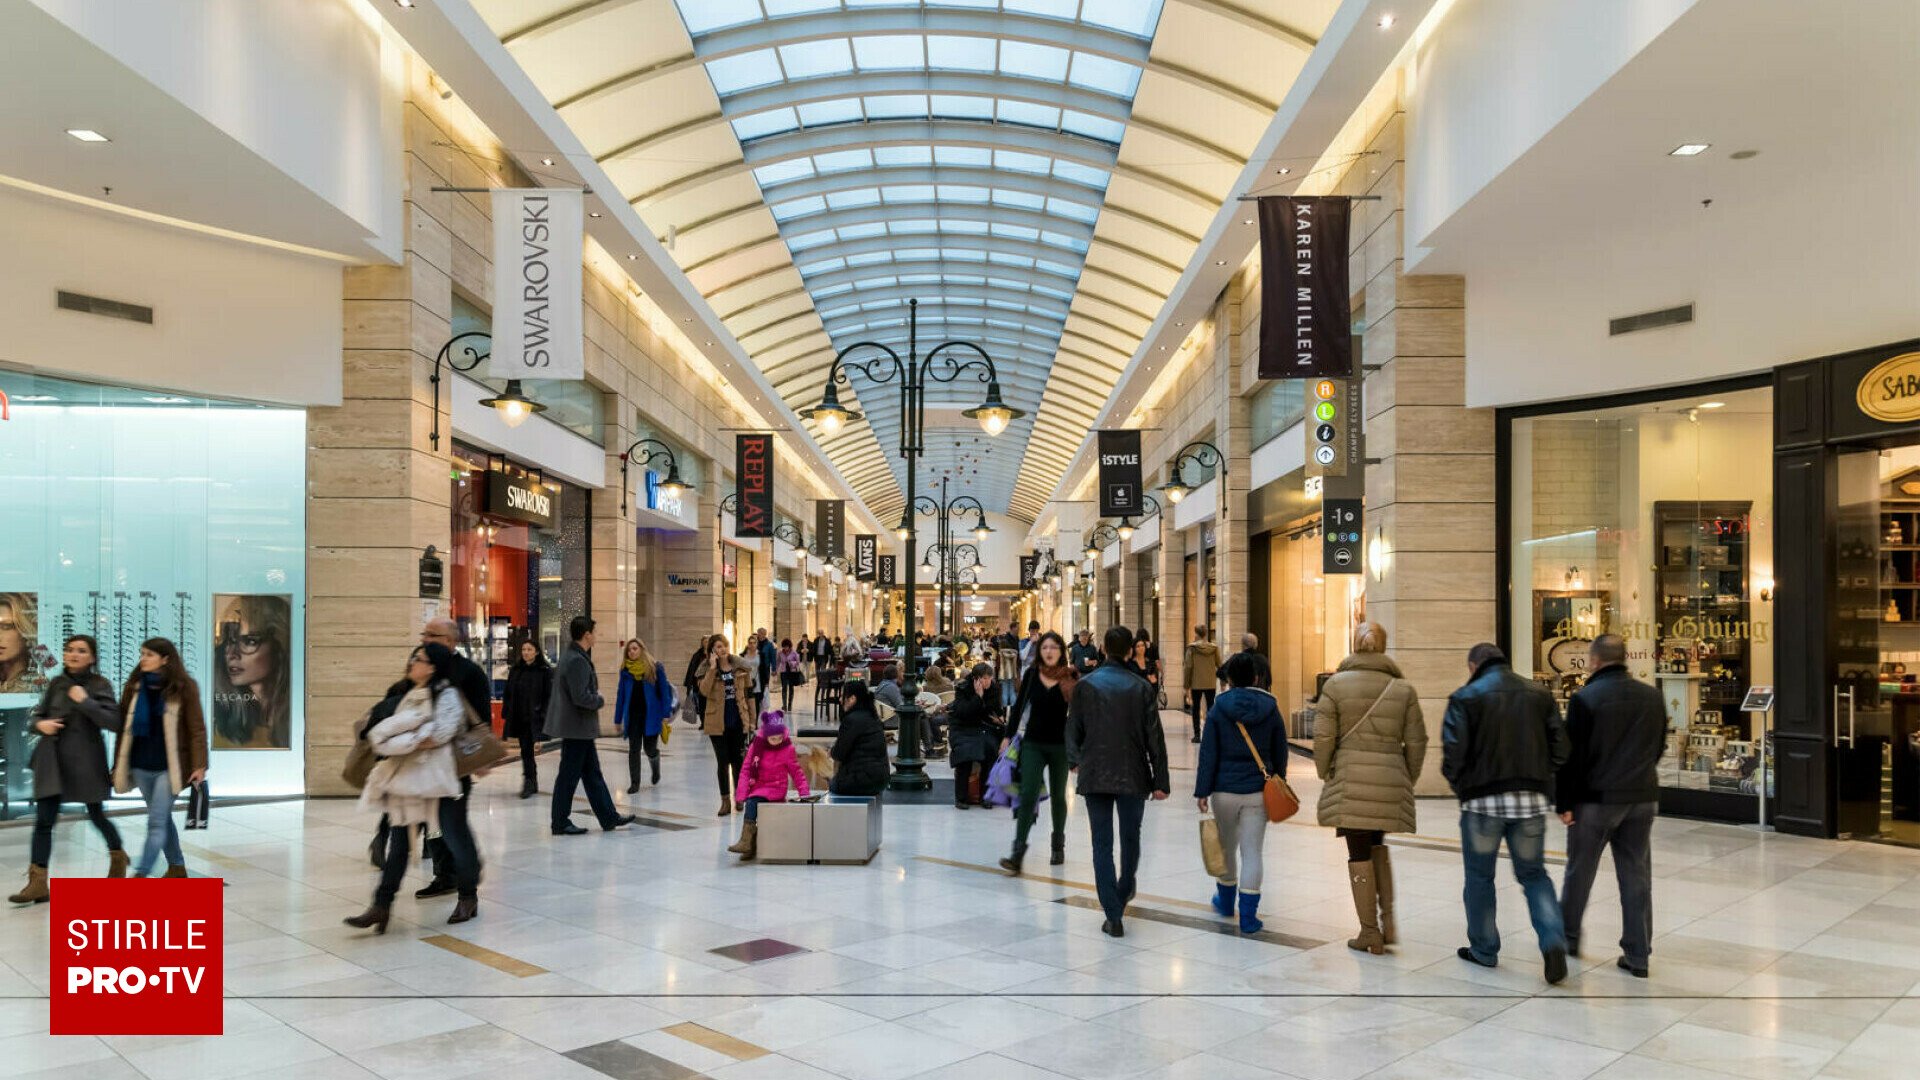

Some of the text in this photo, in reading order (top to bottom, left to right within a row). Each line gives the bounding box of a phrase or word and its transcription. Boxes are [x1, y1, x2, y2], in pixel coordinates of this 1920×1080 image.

[523, 196, 550, 367] SWAROVSKI
[1297, 205, 1312, 365] KAREN MILLEN
[1882, 374, 1920, 400] SAB
[1102, 454, 1138, 465] iSTYLE
[1350, 428, 1358, 464] CHAMPS
[744, 438, 764, 534] REPLAY
[859, 540, 873, 576] VANS
[1672, 615, 1769, 644] Giving
[1570, 658, 1585, 669] 50
[215, 692, 257, 701] ESCADA
